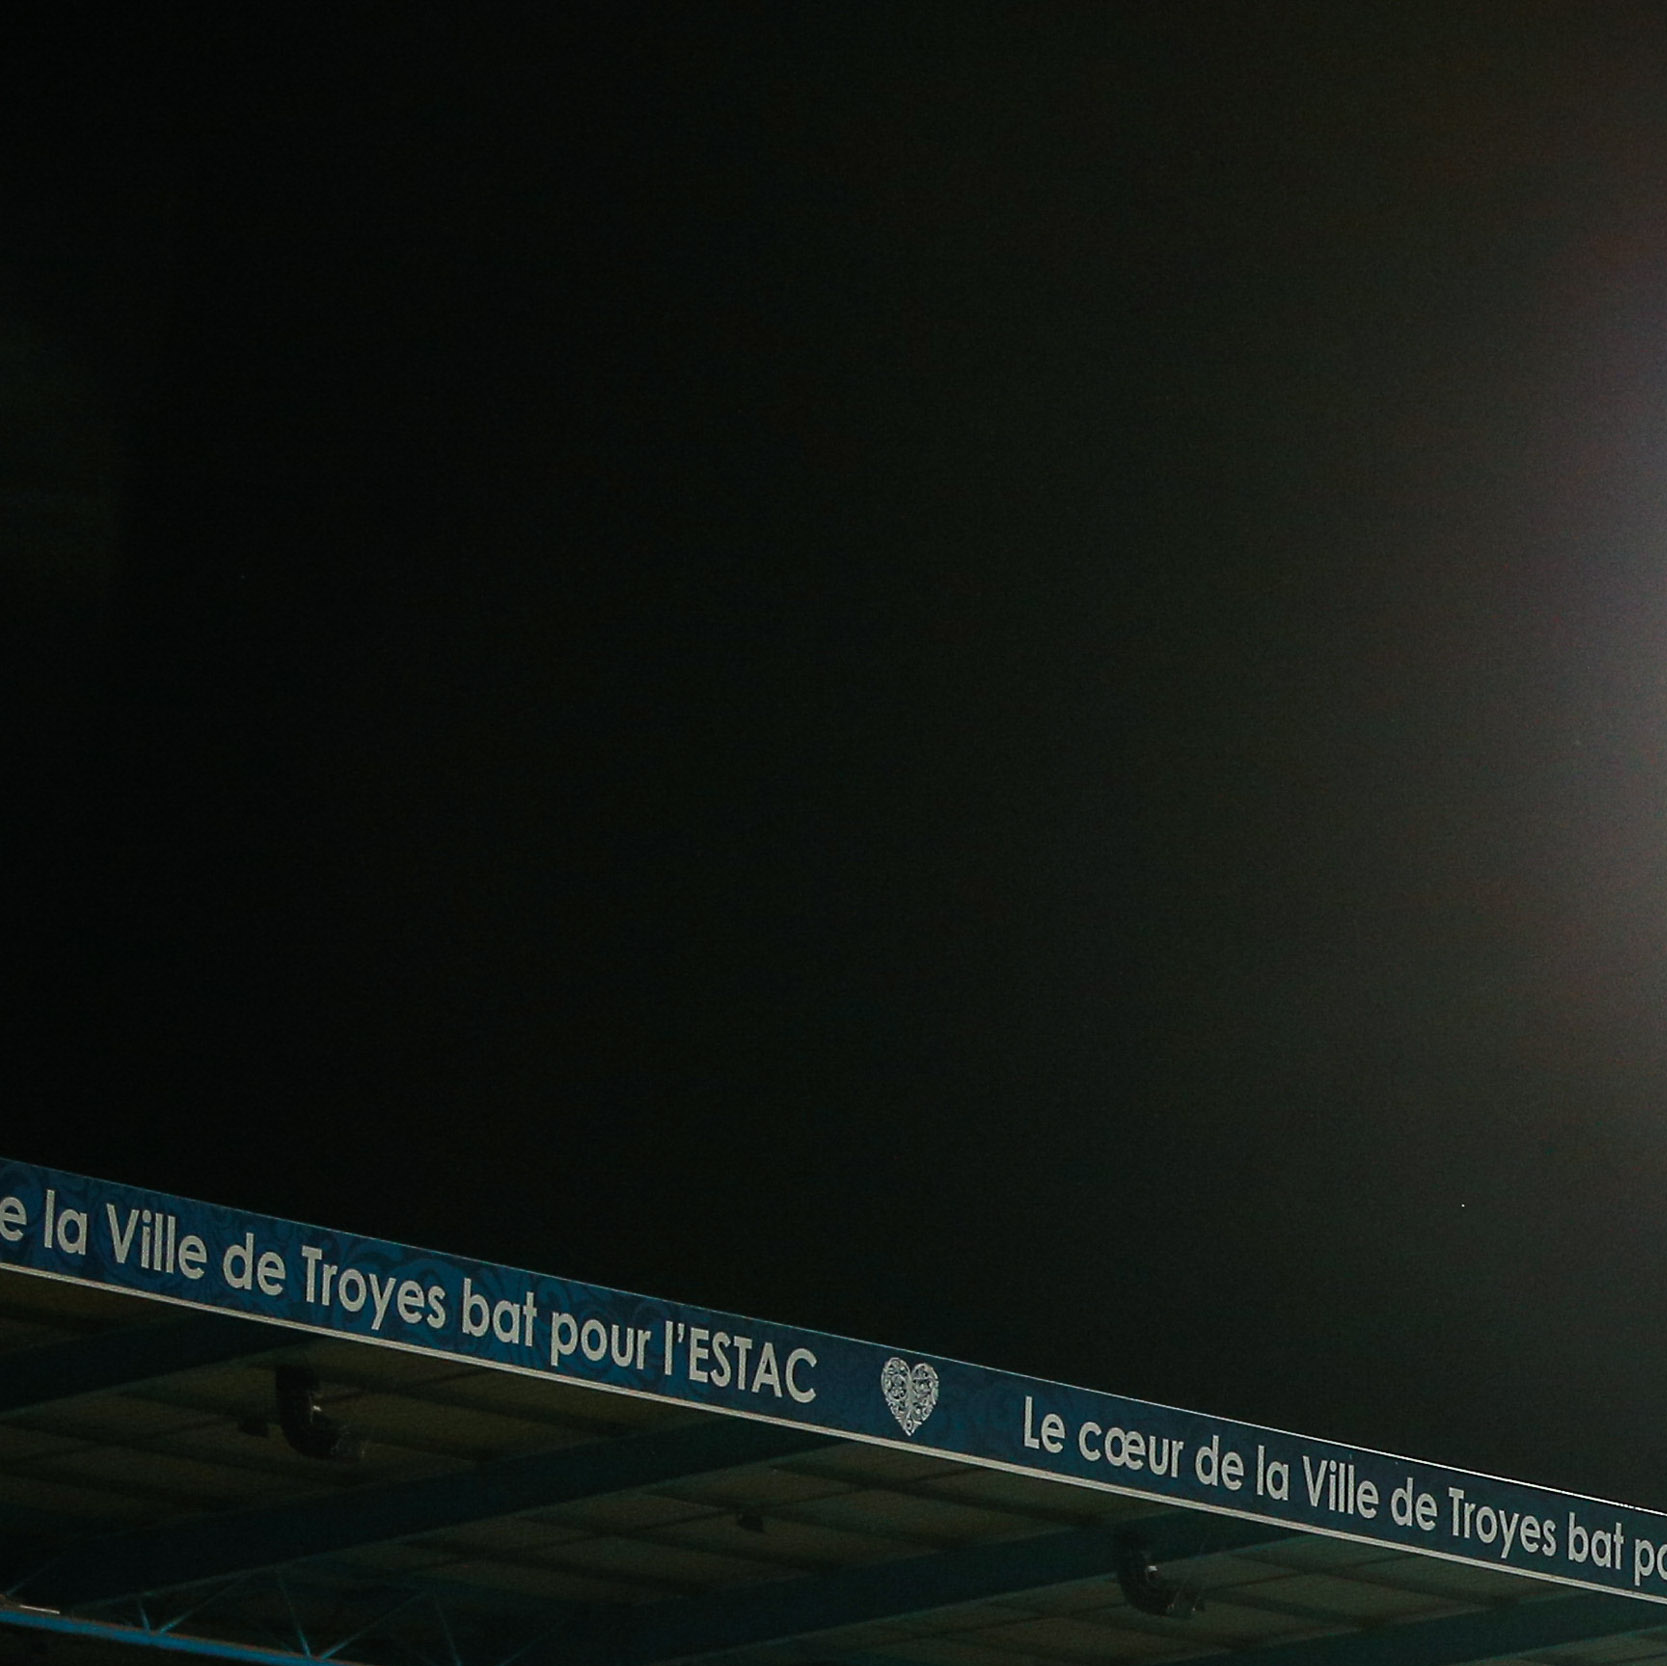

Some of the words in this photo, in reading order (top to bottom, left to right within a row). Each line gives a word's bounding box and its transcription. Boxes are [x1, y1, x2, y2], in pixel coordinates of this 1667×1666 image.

[43, 1190, 88, 1257] la
[106, 1203, 208, 1279] Ville
[221, 1232, 285, 1296] de
[301, 1245, 446, 1332] Troyes
[462, 1279, 538, 1347] bat
[550, 1311, 652, 1367] pour
[663, 1319, 818, 1403] l'ESTAC
[1024, 1395, 1064, 1454] Le
[1078, 1420, 1184, 1479] cœur
[1195, 1435, 1244, 1491] de
[1257, 1445, 1290, 1502] la
[1302, 1454, 1380, 1519] Ville
[1390, 1477, 1438, 1532] de
[1448, 1486, 1557, 1559] Troyes
[1568, 1512, 1624, 1570] bat
